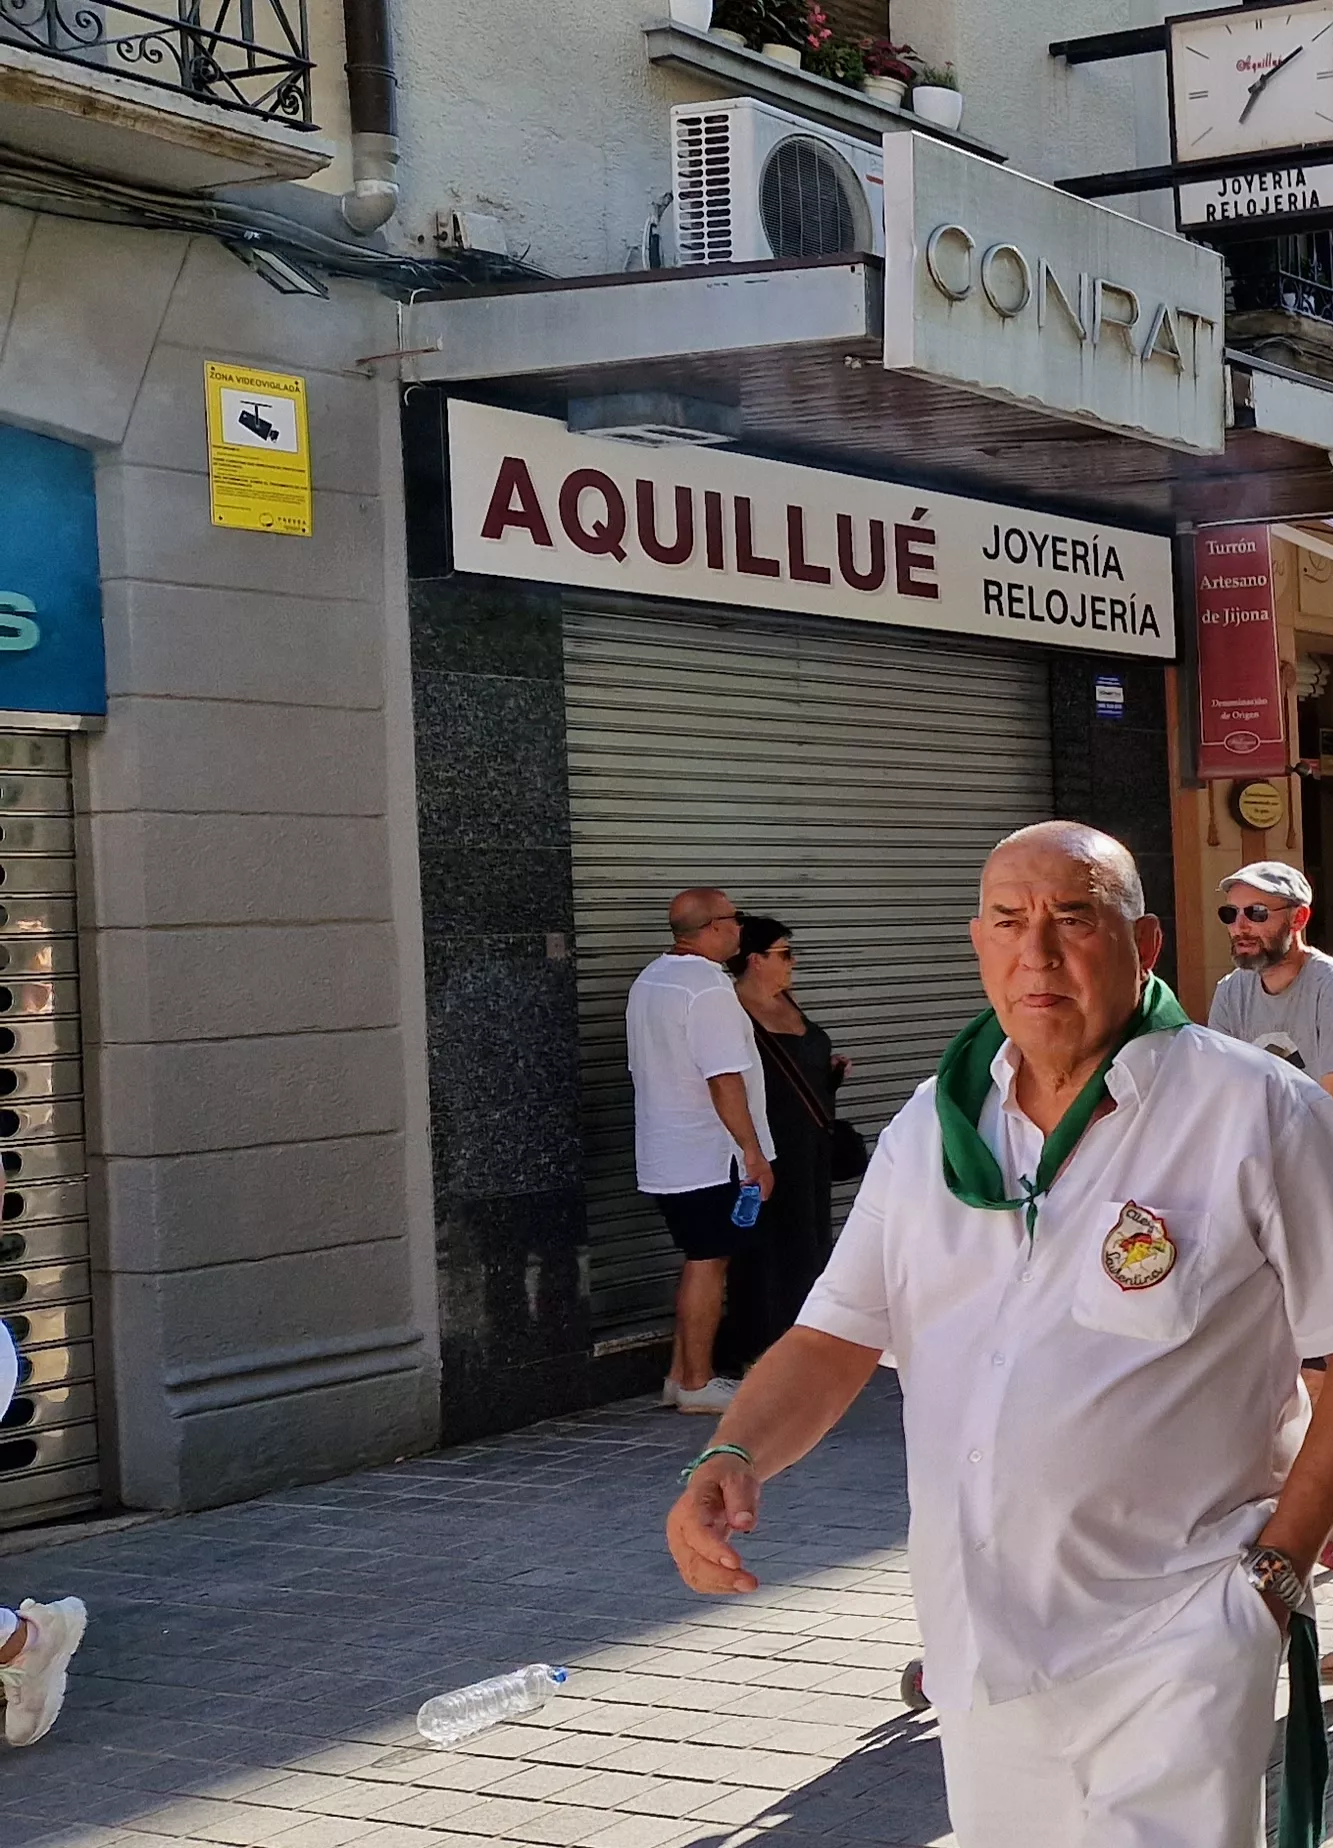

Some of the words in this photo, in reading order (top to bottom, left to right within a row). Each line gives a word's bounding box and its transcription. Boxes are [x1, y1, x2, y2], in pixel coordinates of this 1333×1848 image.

[926, 223, 1217, 371] CONRAT
[209, 371, 234, 382] ZONA
[235, 376, 301, 393] VIDEOVIGILADA
[481, 455, 940, 600] AQUILLUÉ
[1205, 538, 1256, 556] Turrón
[982, 523, 1125, 582] JOYERÍA
[1199, 574, 1267, 590] Artesano
[982, 579, 1161, 640] RELOJERÍA
[1201, 608, 1220, 624] de
[1222, 607, 1269, 627] Jijona
